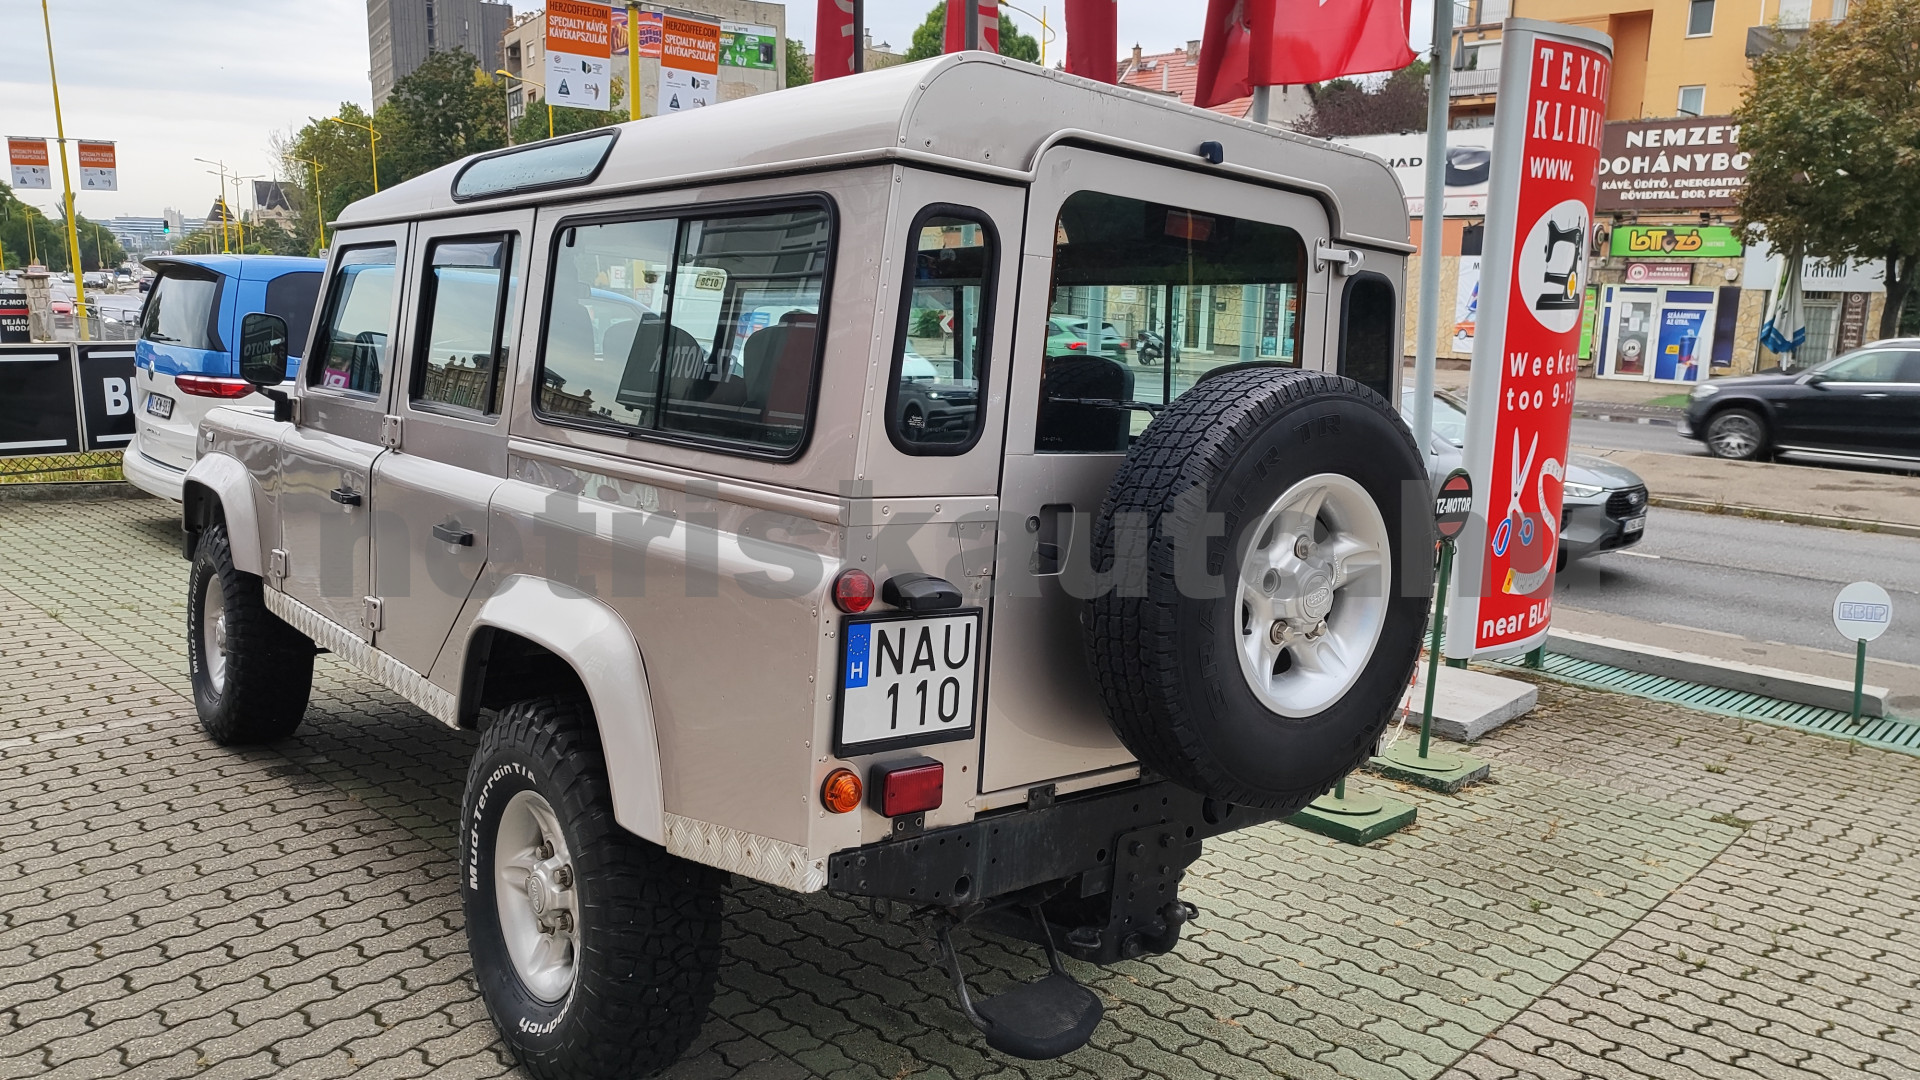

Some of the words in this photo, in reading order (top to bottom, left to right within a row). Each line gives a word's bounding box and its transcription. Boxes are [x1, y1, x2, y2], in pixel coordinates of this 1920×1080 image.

[549, 1, 608, 19] HERZCOFFEE.COM
[549, 15, 585, 30] SPECIALTY
[585, 20, 608, 34] KÁVÉK
[665, 20, 717, 38] HERZCOFFEE.COM
[549, 26, 608, 45] KÁVÉKAPSZULÁK
[664, 34, 697, 48] SPECIALTY
[697, 38, 717, 52] KÁVÉK
[664, 43, 716, 63] KÁVÉKAPSZULÁK
[1507, 387, 1543, 411] too
[1436, 497, 1471, 514] TZ-MOTOR
[1482, 612, 1525, 639] near
[876, 622, 972, 678] NAU
[850, 661, 863, 680] H
[887, 676, 960, 730] 110
